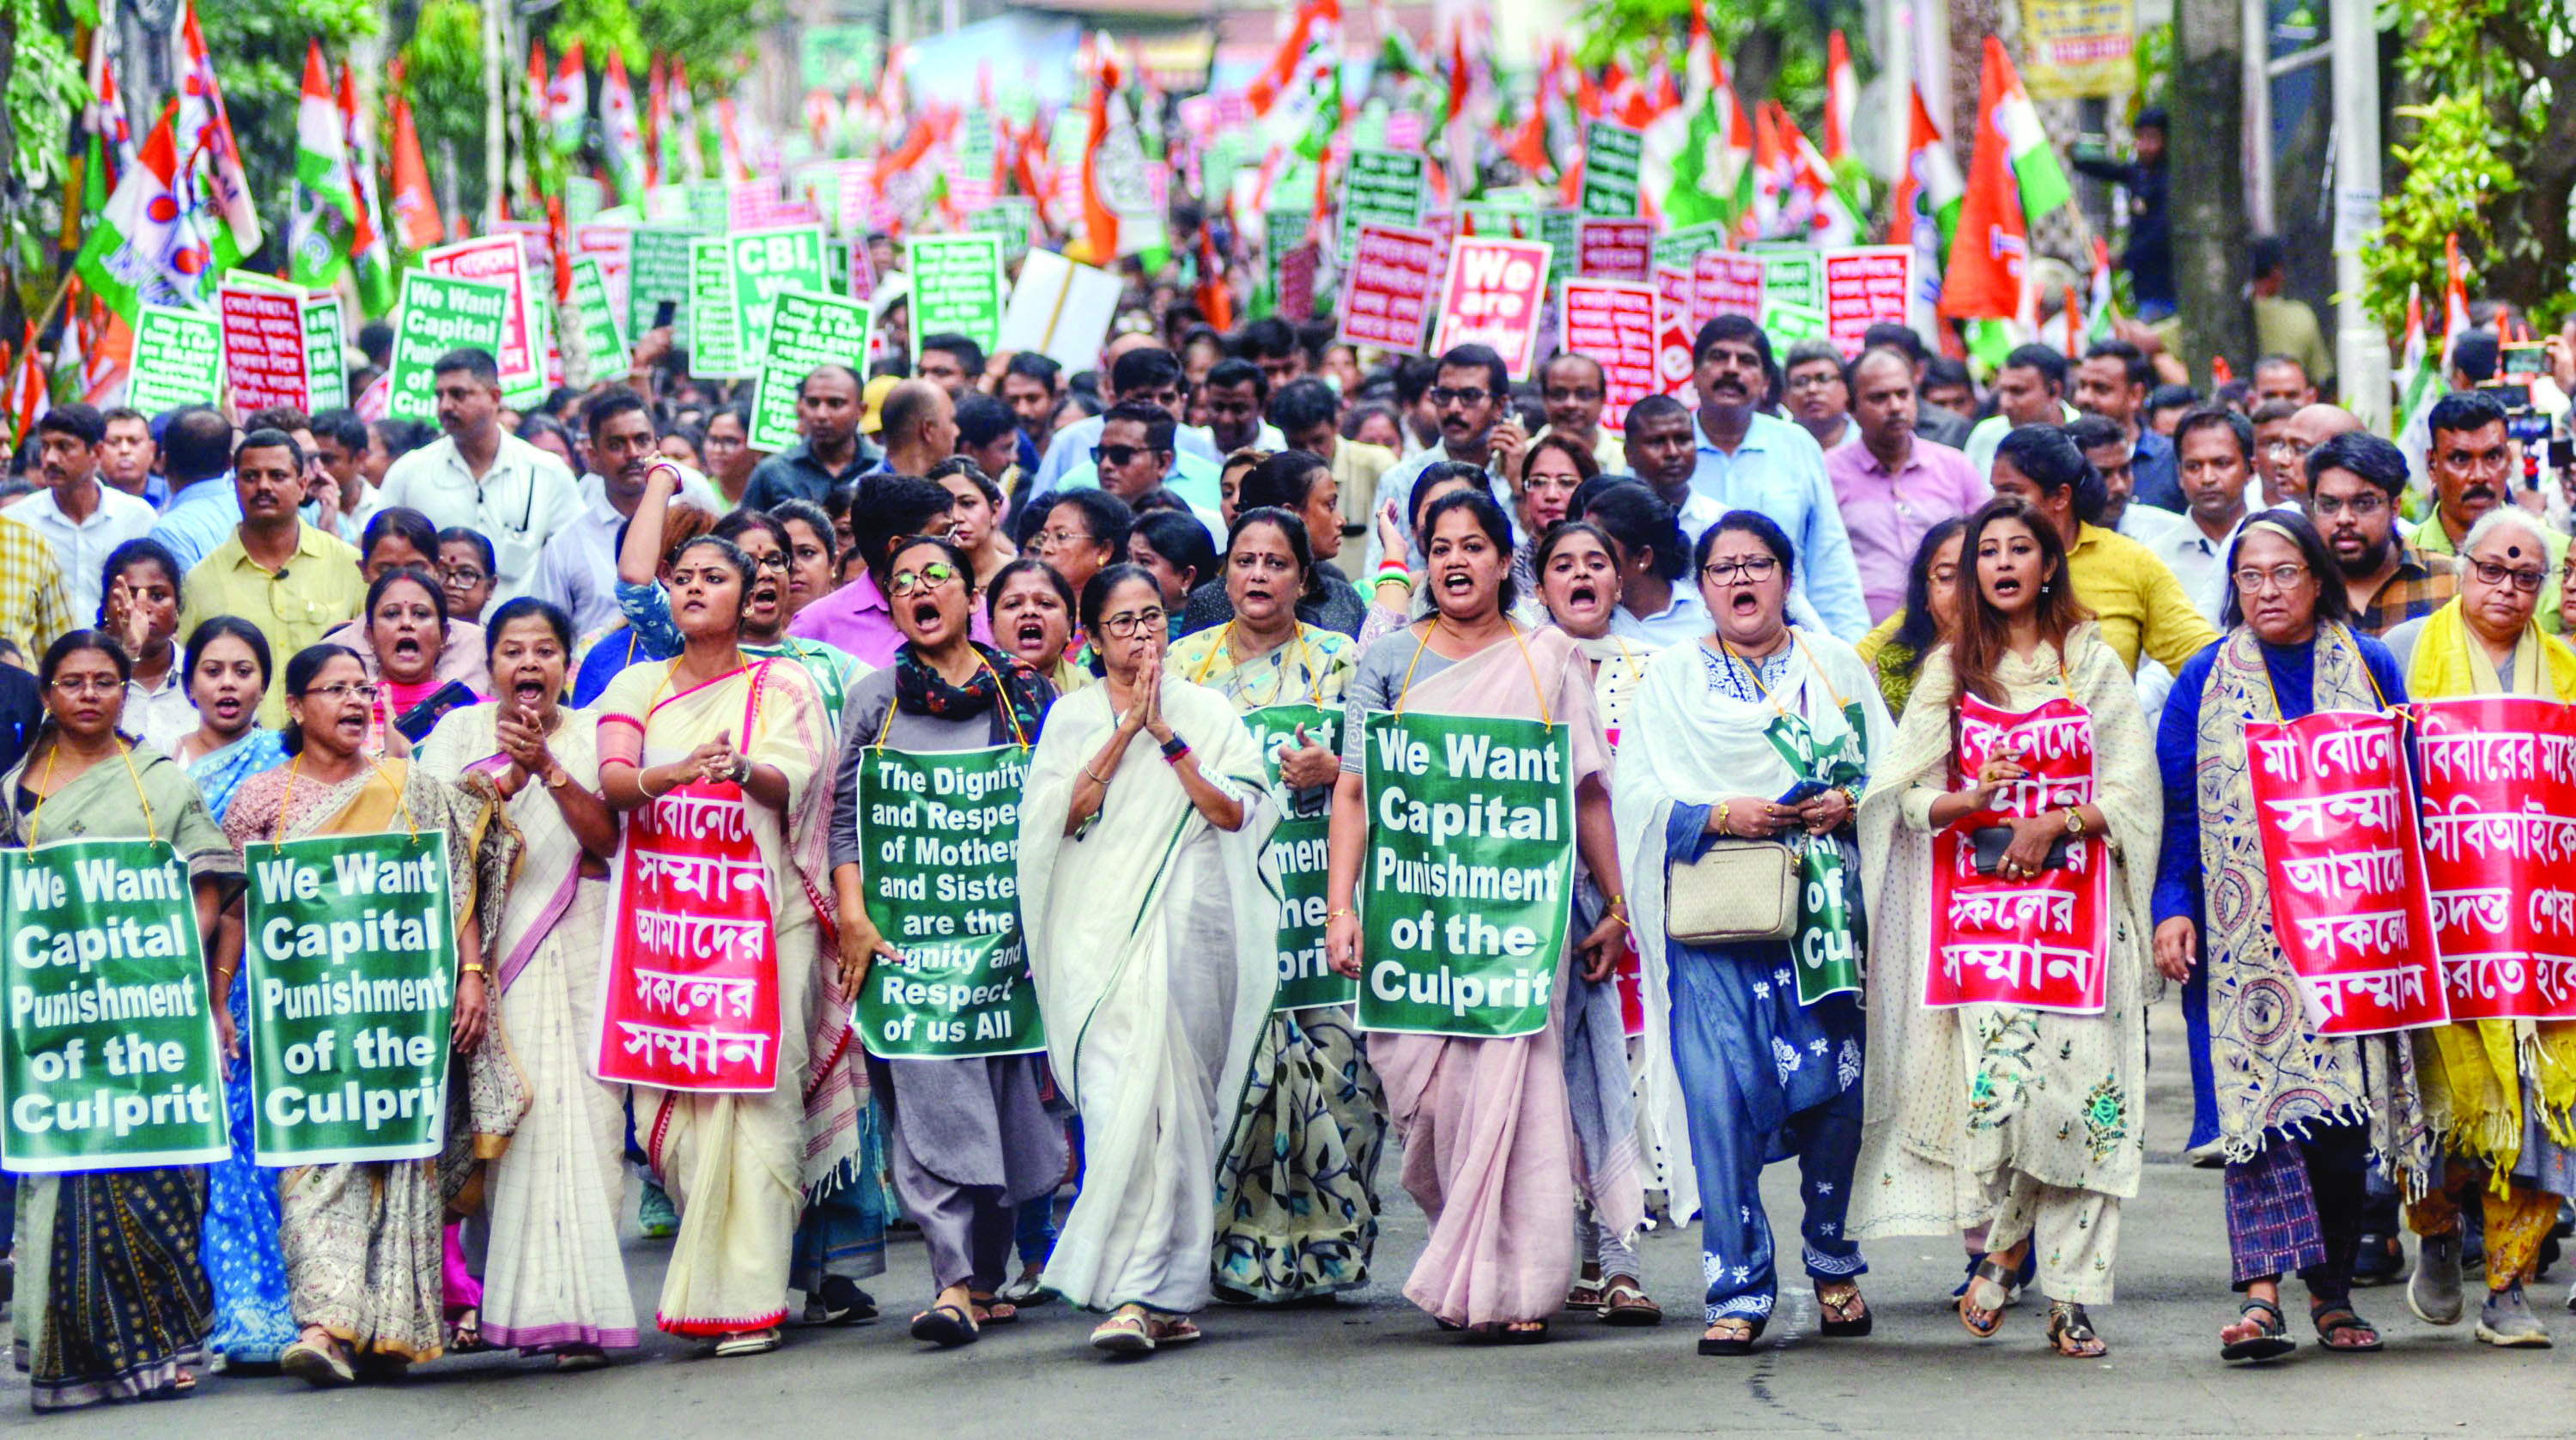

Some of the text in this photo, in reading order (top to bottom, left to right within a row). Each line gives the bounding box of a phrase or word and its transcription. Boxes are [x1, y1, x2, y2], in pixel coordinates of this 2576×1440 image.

[737, 234, 817, 275] CBI,
[1464, 248, 1535, 291] We
[410, 281, 503, 317] We Want
[754, 275, 805, 301] We
[1458, 291, 1524, 316] are
[406, 309, 498, 343] Capital
[405, 368, 434, 392] of
[1376, 727, 1560, 784] We Want
[2257, 732, 2299, 783] মা
[2415, 715, 2537, 785] বিবারের
[878, 759, 1029, 801] The Dignity
[872, 800, 1022, 835] and Respe
[1379, 786, 1558, 847] Capital
[634, 848, 770, 902] সম্মান
[881, 835, 1020, 866] of Mother
[1376, 846, 1558, 902] Punishment
[11, 858, 182, 912] We Want
[256, 851, 439, 903] We Want
[879, 873, 1020, 902] and Siste
[1807, 867, 1844, 914] of
[262, 907, 441, 965] Capital
[635, 907, 768, 962] আমাদের
[902, 908, 1015, 936] are the
[1279, 896, 1328, 939] he
[1390, 909, 1537, 957] of the
[13, 914, 187, 973] Capital
[989, 937, 1022, 969] and
[1940, 937, 2094, 993] সম্মান
[11, 973, 197, 1030] Punishment
[262, 966, 449, 1022] Punishment
[633, 967, 757, 1020] সকলের
[882, 975, 1014, 1012] Respect
[1370, 959, 1552, 1018] Culprit
[284, 1026, 436, 1075] of the
[616, 1020, 772, 1075] সম্মান
[884, 1010, 1012, 1042] of us All
[31, 1032, 185, 1083] of the
[11, 1083, 212, 1137] Culprit
[264, 1076, 440, 1131] Culpri
